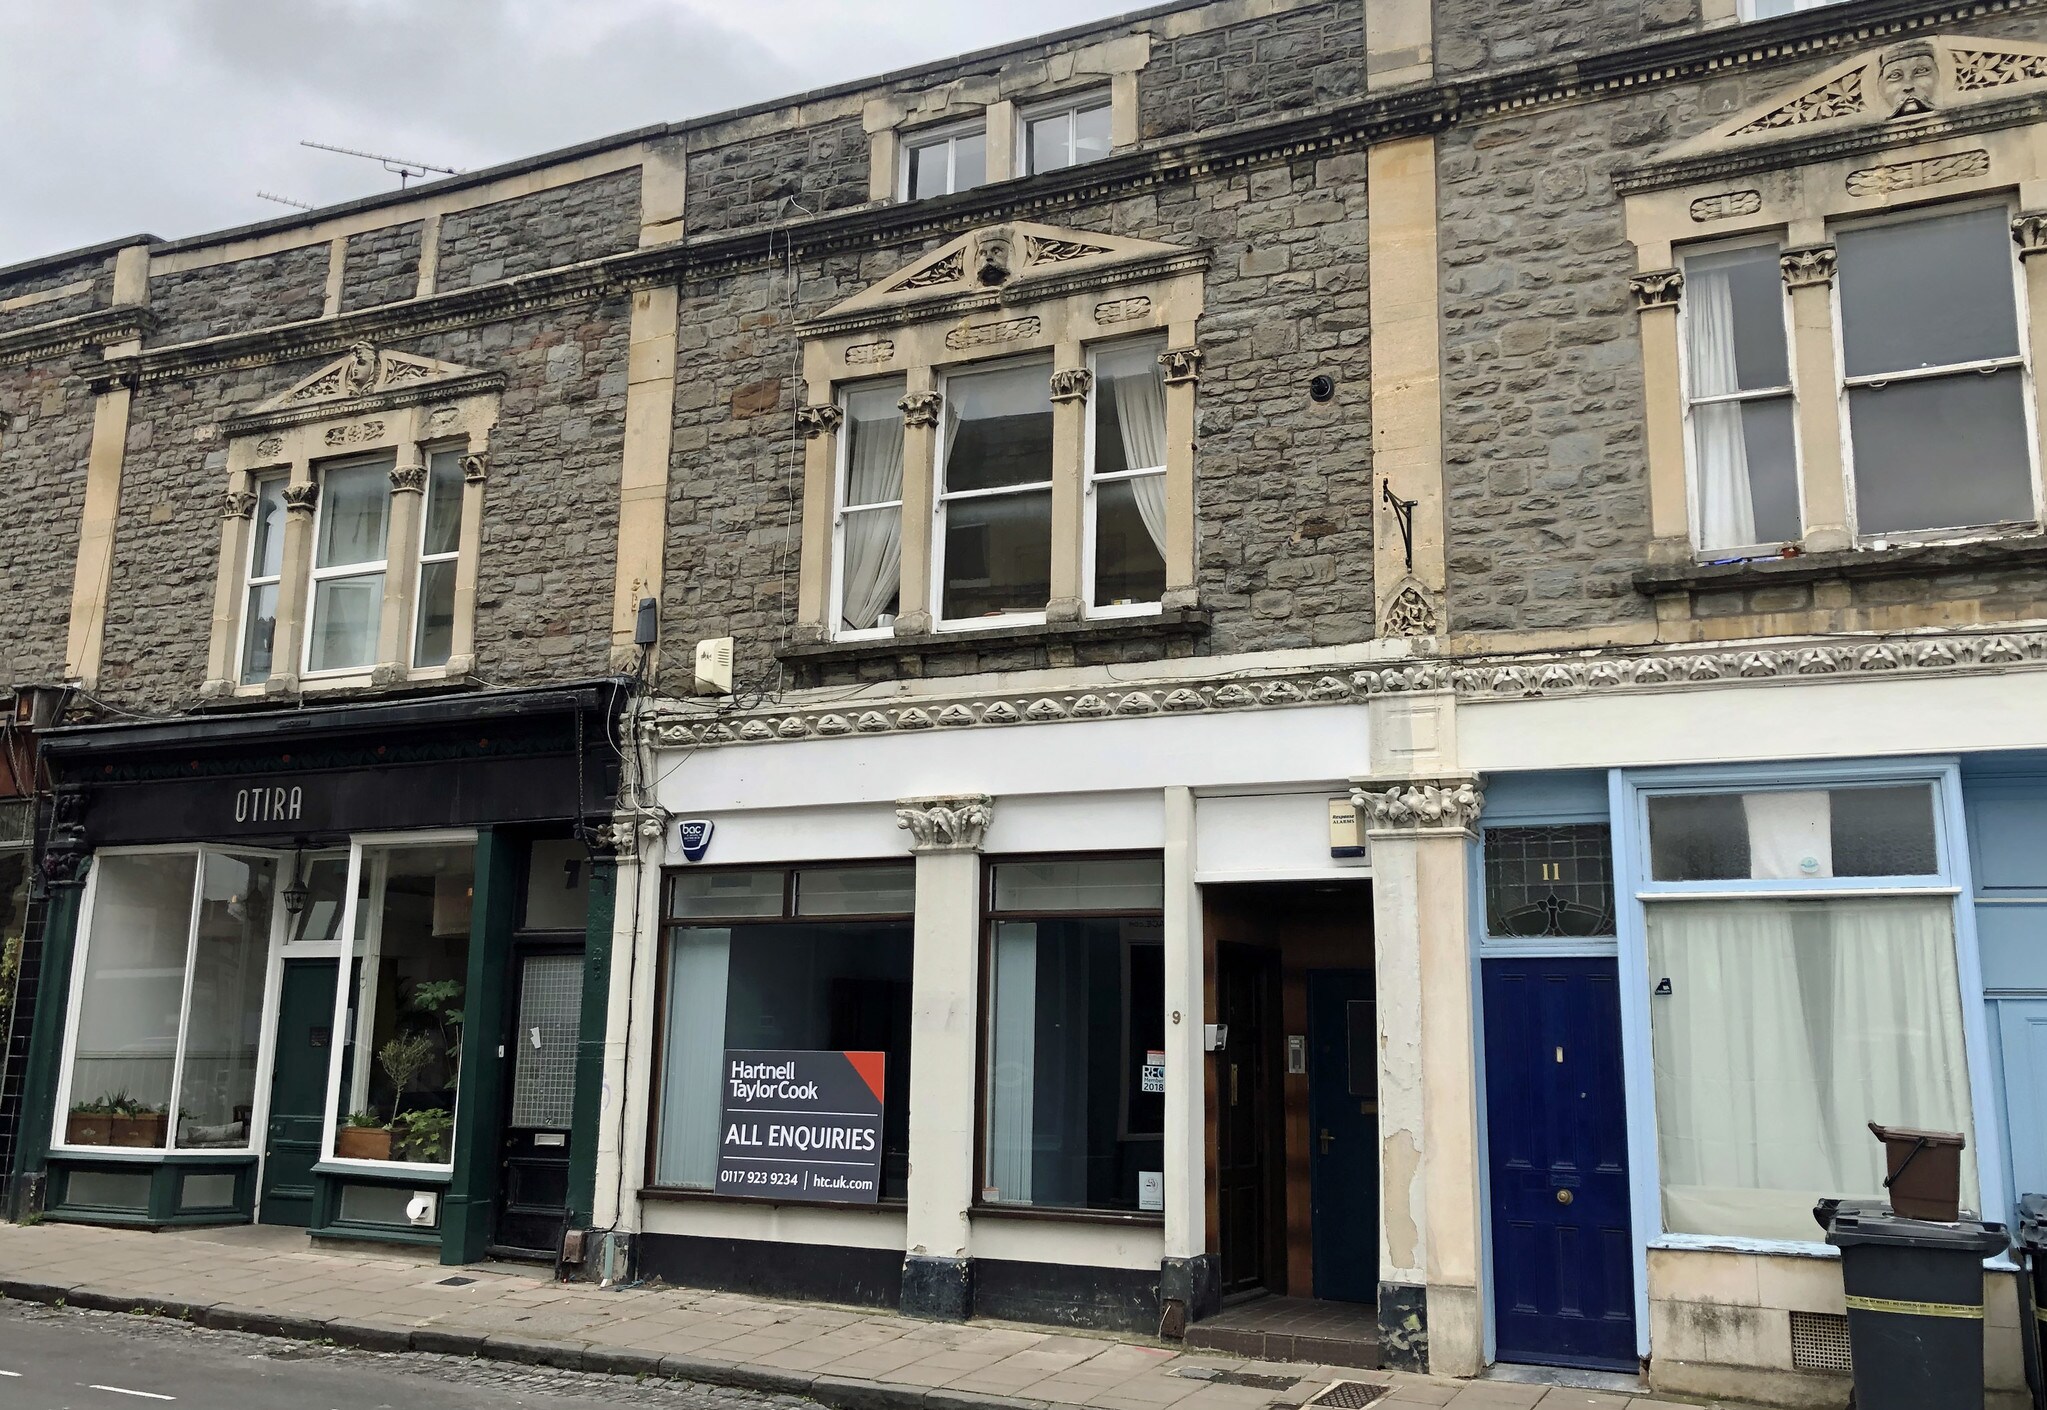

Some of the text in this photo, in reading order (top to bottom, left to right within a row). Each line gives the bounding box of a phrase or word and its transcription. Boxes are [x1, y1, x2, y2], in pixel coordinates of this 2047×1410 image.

[235, 785, 302, 823] OTIRA
[682, 824, 701, 834] bac
[1172, 1010, 1181, 1025] 9
[731, 1060, 795, 1080] Hartnell
[1144, 1083, 1164, 1091] 2018
[725, 1123, 875, 1151] ALL ENQUIRIES
[721, 1170, 873, 1190] 0117 923 9234 htc.uk.com
